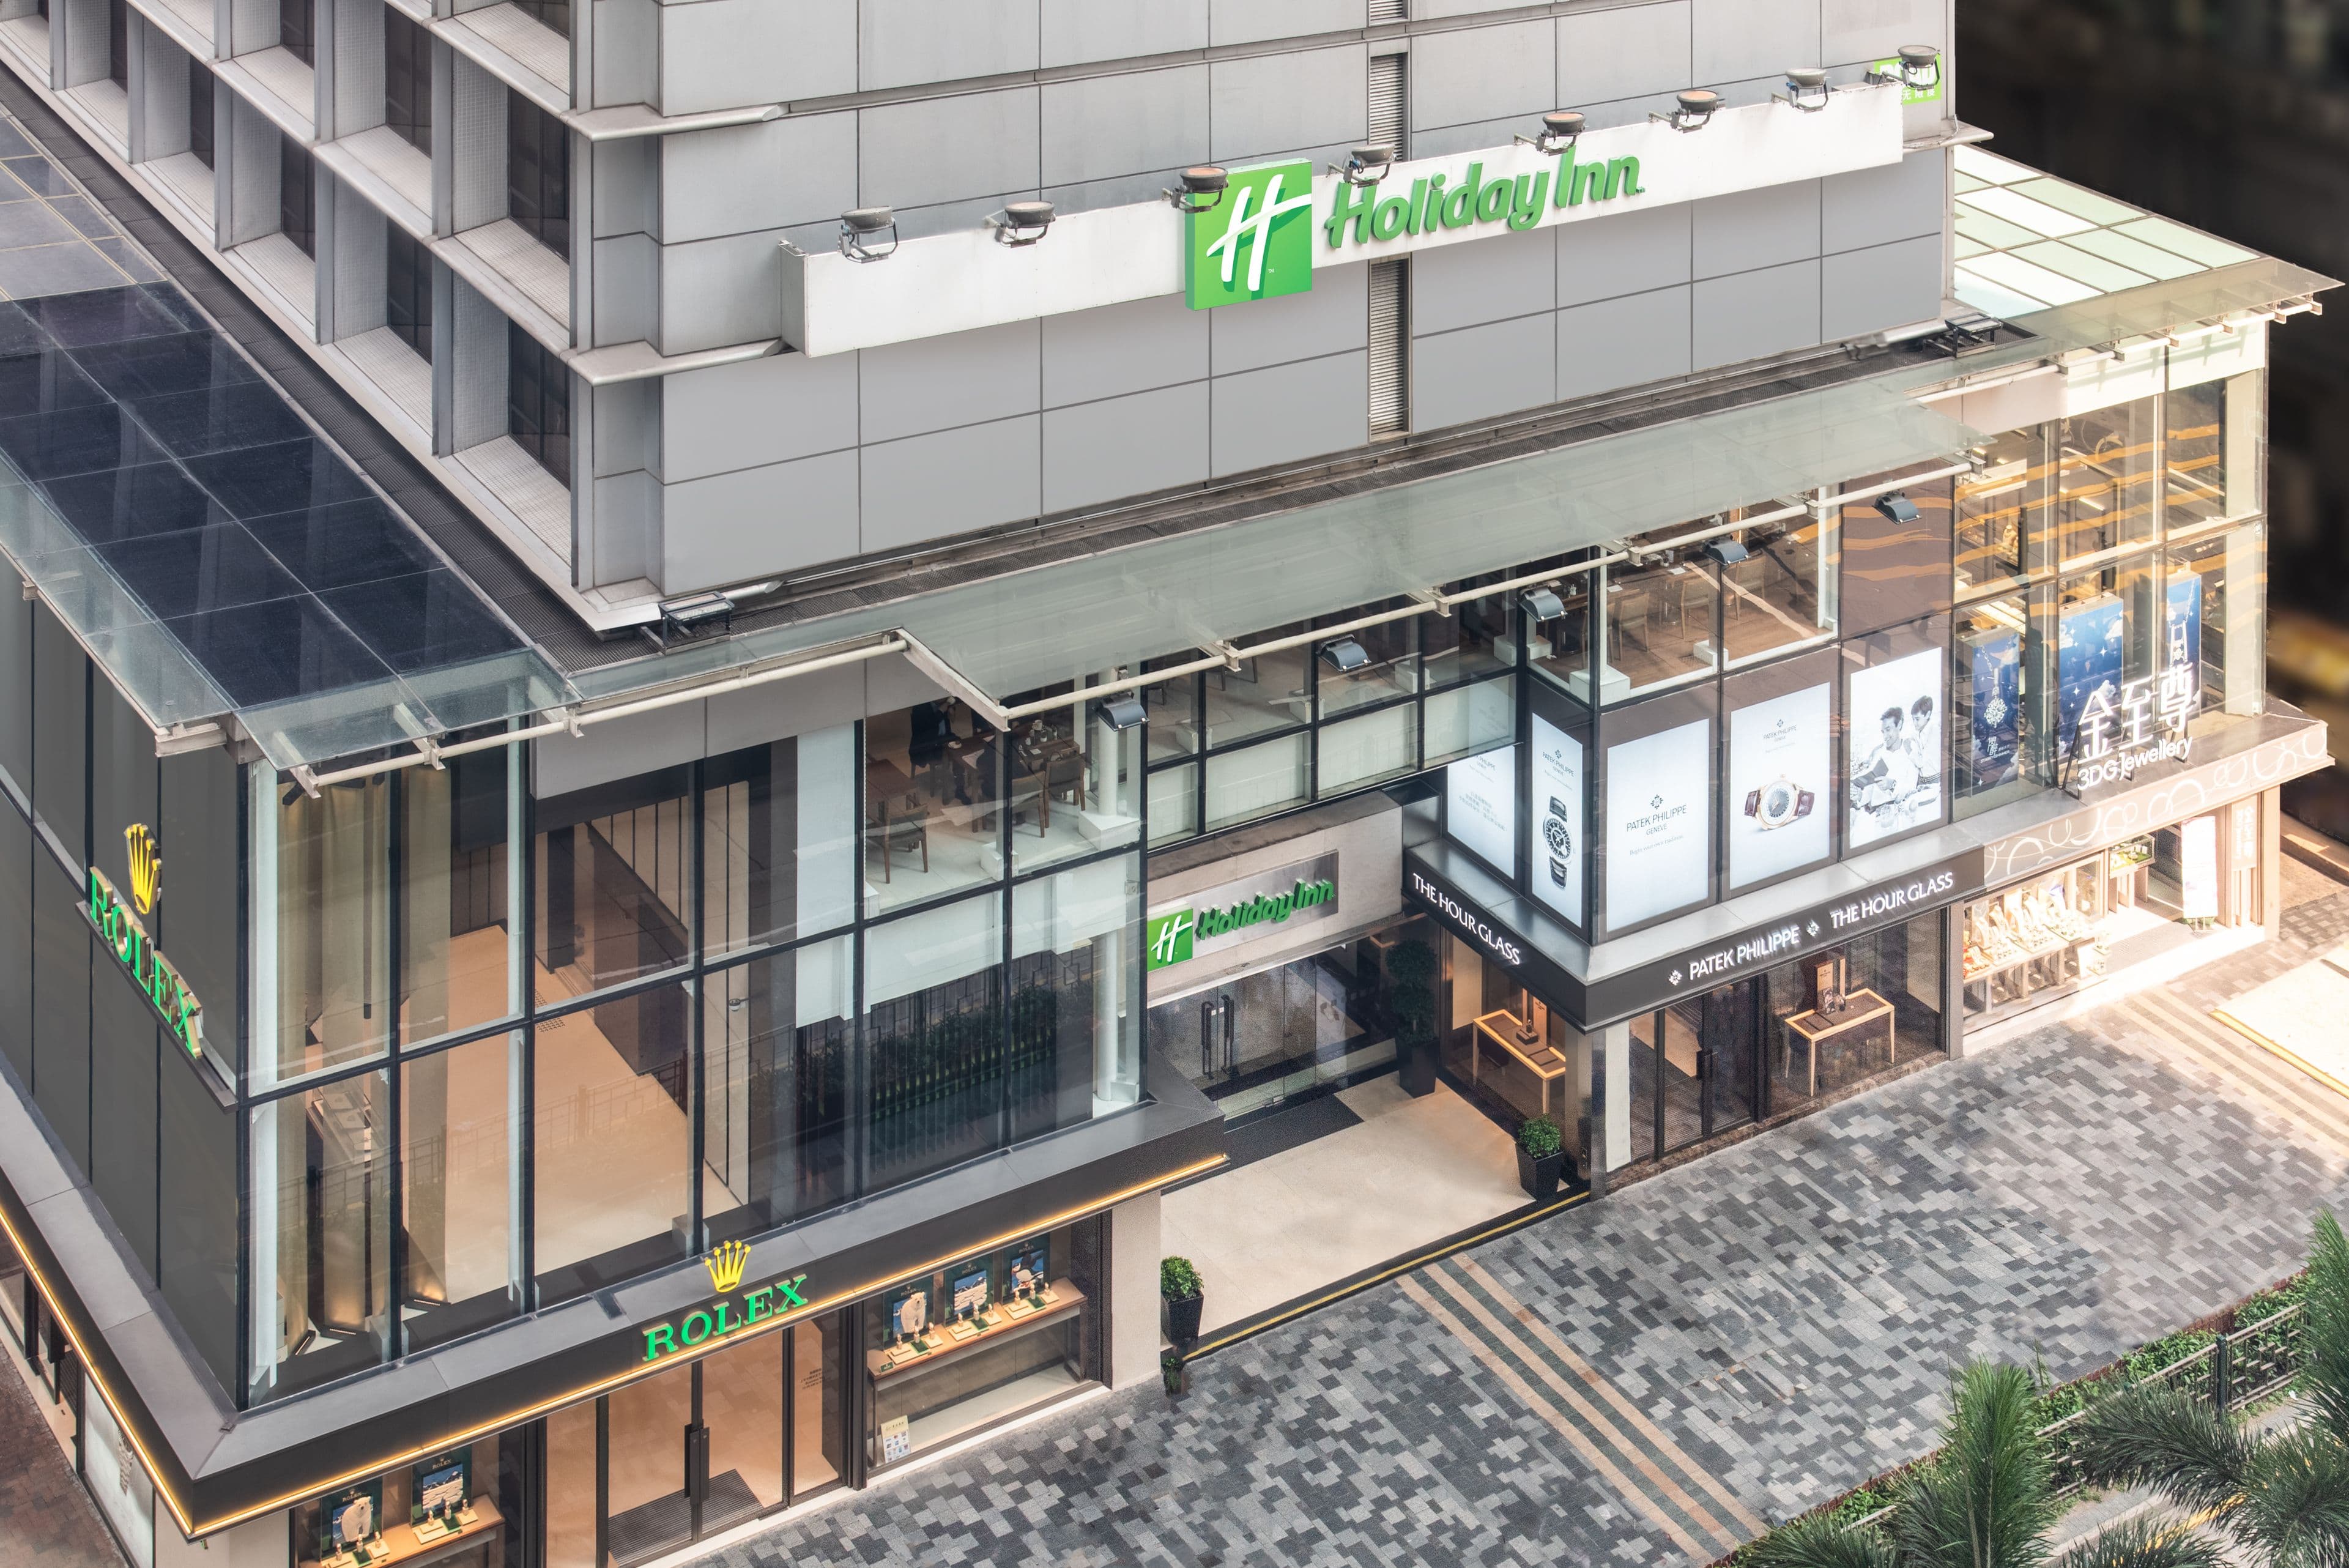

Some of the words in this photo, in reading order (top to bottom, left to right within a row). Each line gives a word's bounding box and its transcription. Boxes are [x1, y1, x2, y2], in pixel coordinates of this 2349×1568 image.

[1324, 161, 1550, 248] Holiday
[1554, 144, 1640, 209] Inn
[2077, 662, 2193, 765] 金至尊
[2077, 759, 2121, 790] 3DG
[2118, 737, 2193, 781] Jewellery
[1627, 816, 1651, 832] PATEK
[1652, 804, 1688, 824] PHILIPPE
[1196, 891, 1294, 940] Holiday
[1293, 878, 1334, 910] Inn
[1412, 872, 1437, 904] THE
[1439, 892, 1477, 935] HOUR
[1478, 924, 1520, 965] GLASS
[1830, 905, 1860, 929] THE
[1861, 890, 1907, 919] HOUR
[1907, 872, 1954, 902] GLASS
[89, 866, 202, 1059] ROLEX
[1689, 948, 1735, 980] PATEK
[1737, 925, 1800, 964] PHILIPPE
[642, 1273, 808, 1362] ROLEX
[432, 1458, 452, 1470] ROLEX
